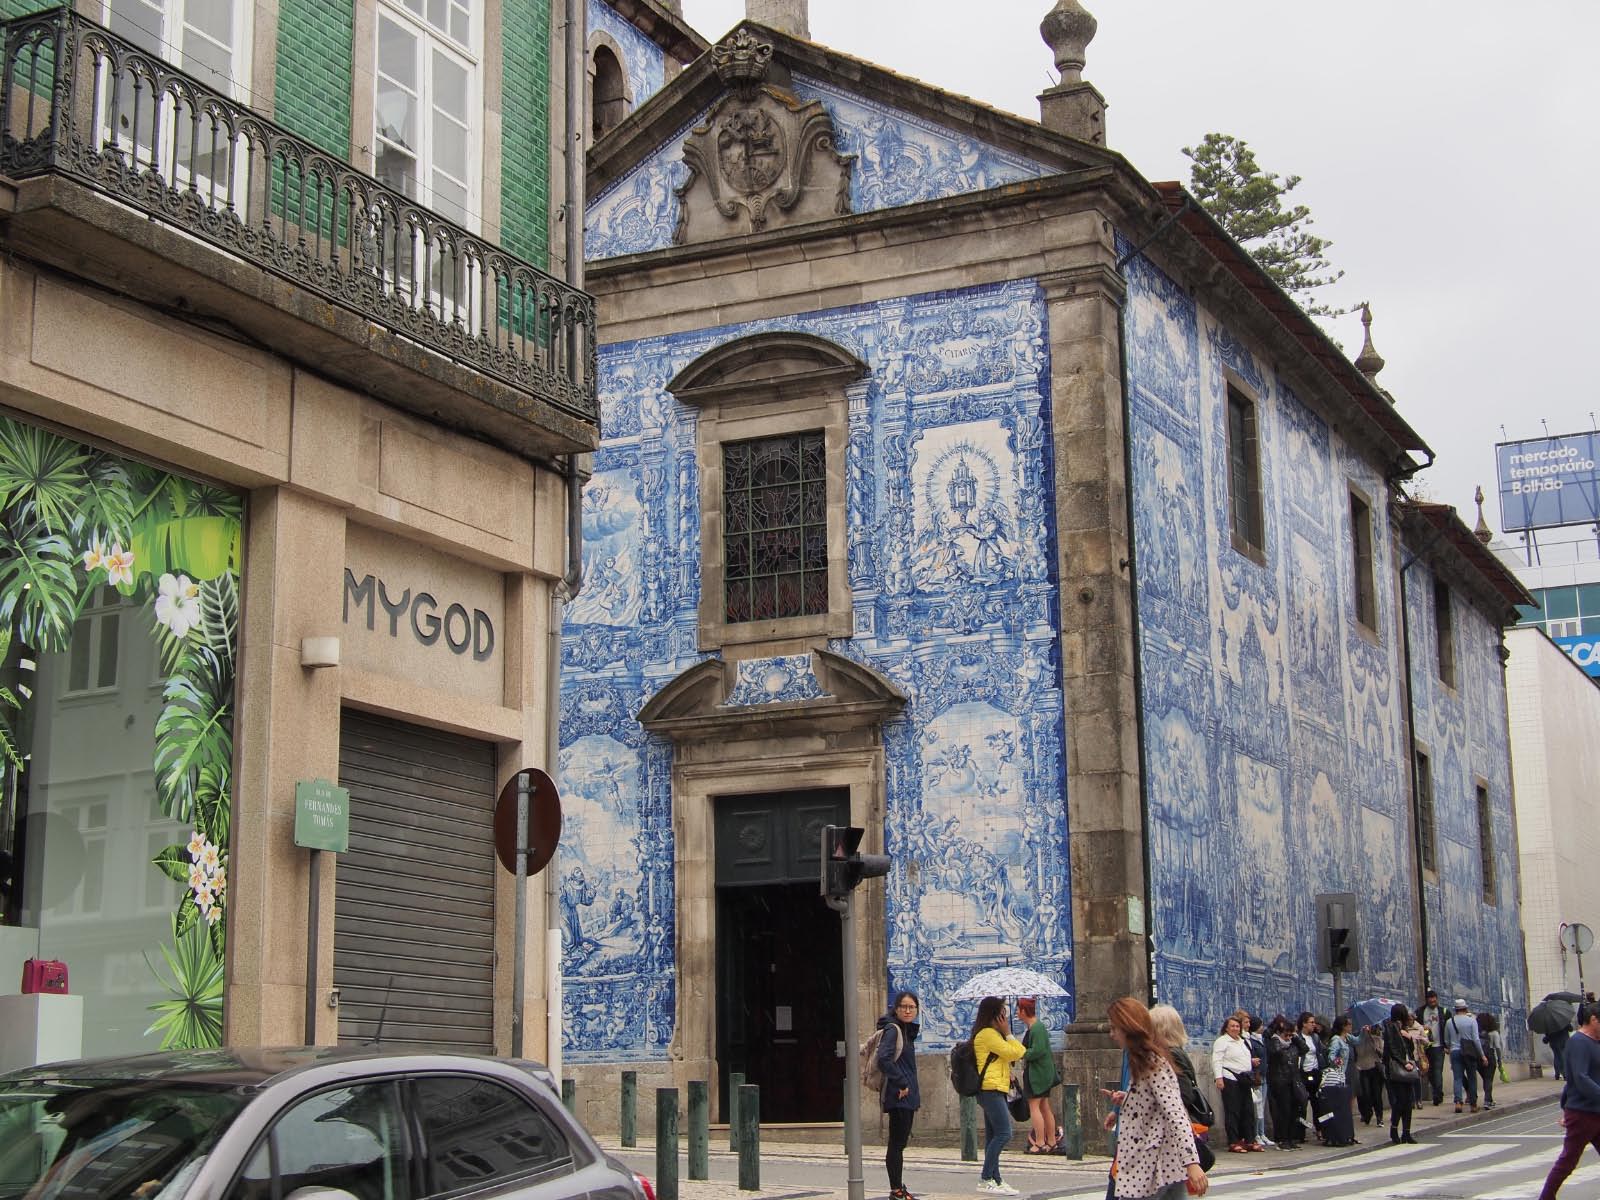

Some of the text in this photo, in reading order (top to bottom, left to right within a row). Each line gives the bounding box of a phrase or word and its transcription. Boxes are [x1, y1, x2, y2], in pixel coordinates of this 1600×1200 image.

[1510, 445, 1578, 464] mercado
[1510, 457, 1594, 479] temporário
[1512, 477, 1563, 495] Bolhão
[343, 567, 495, 662] MYGOD
[304, 799, 342, 815] FERNANDES
